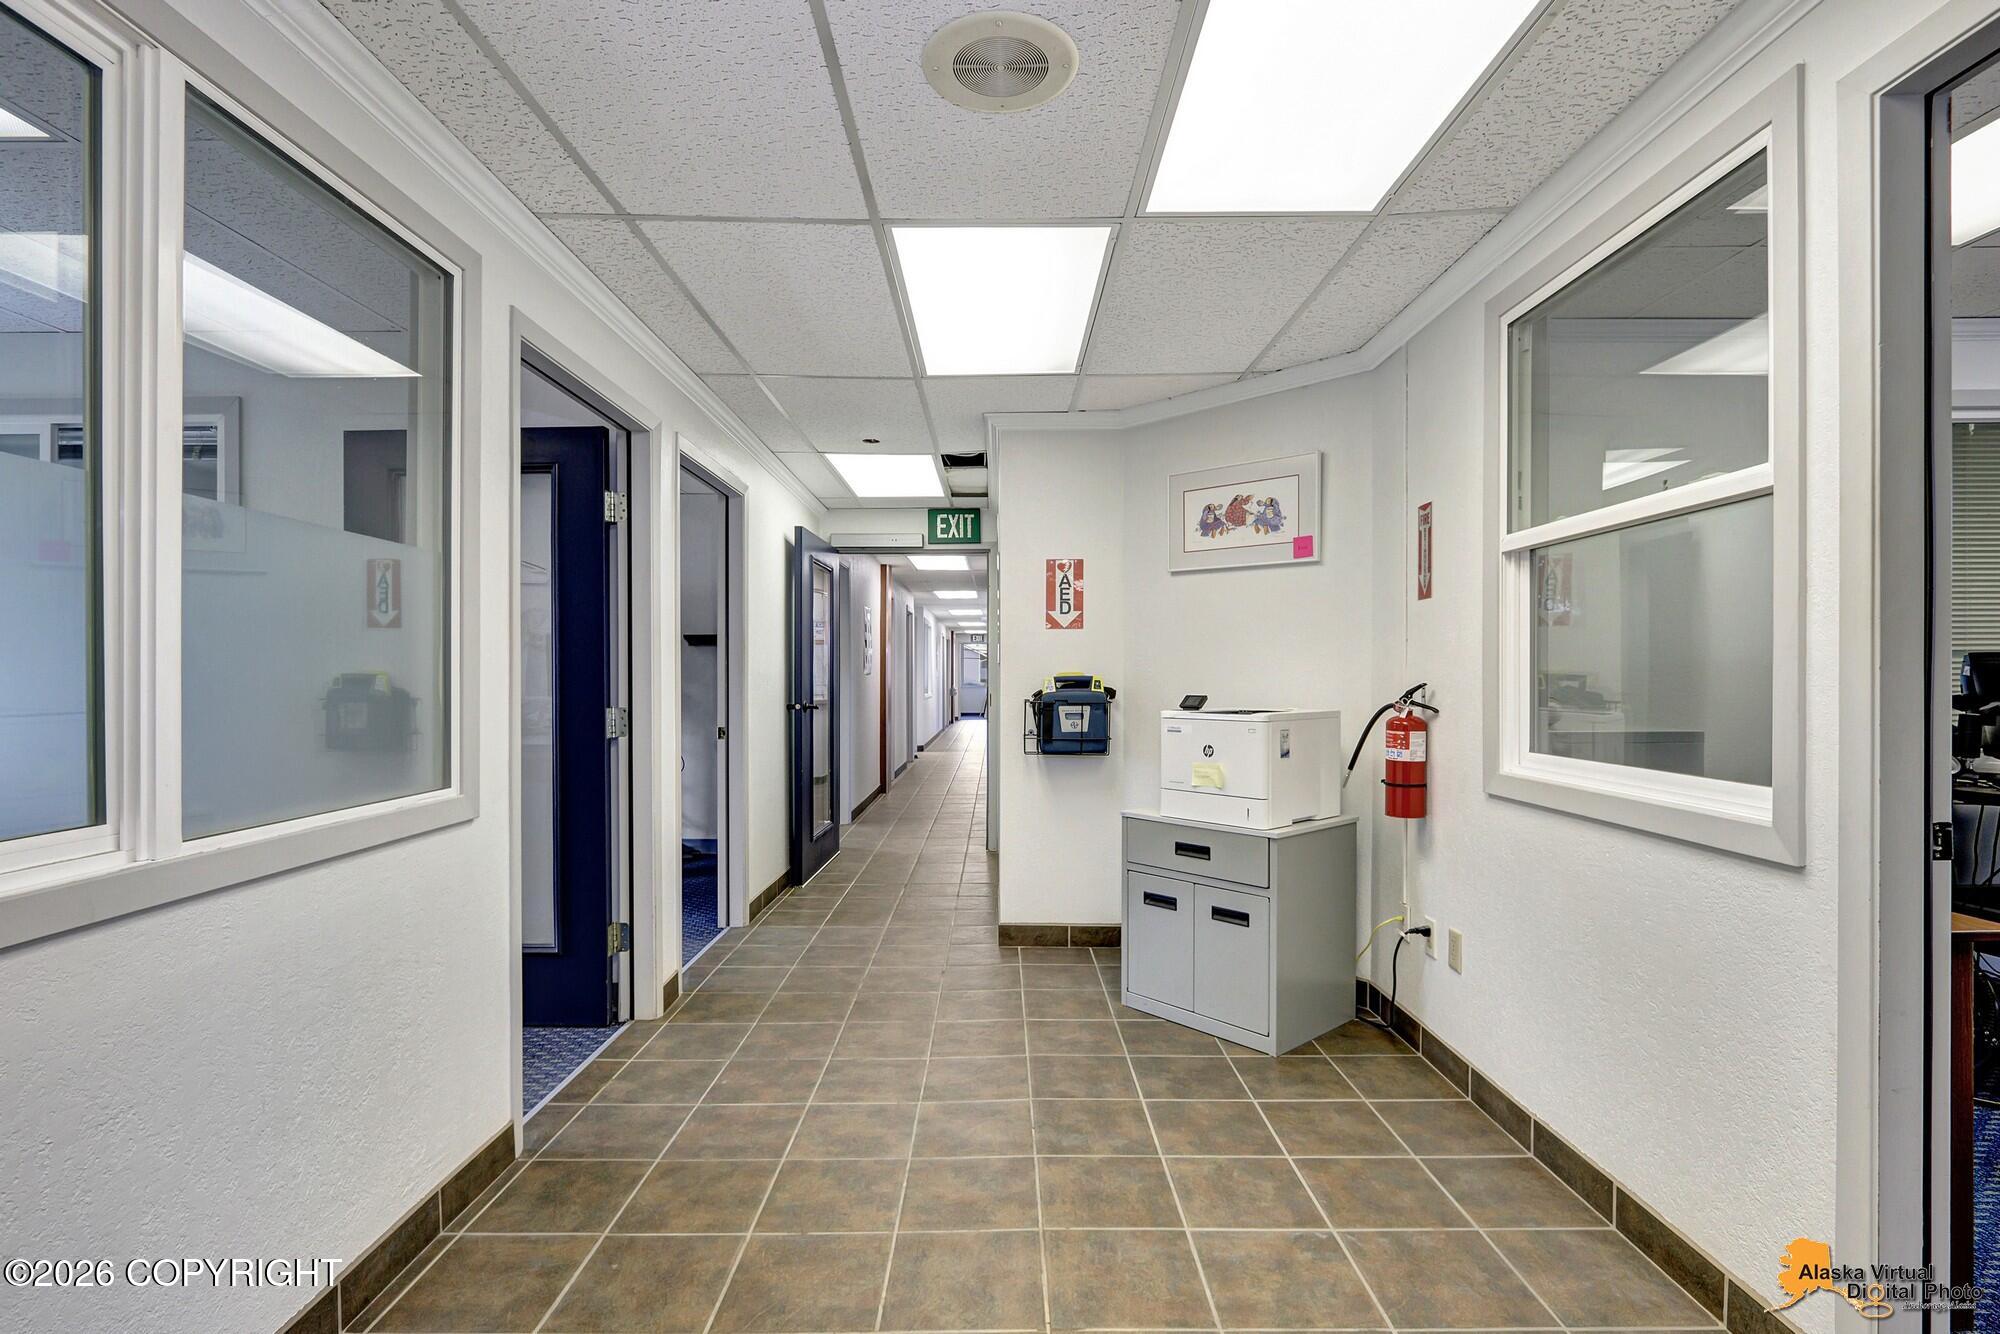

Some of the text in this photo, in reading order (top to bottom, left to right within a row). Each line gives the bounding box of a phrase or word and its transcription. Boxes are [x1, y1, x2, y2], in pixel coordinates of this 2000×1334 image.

[936, 514, 975, 538] EXIT
[1059, 573, 1072, 615] AED
[1203, 744, 1214, 758] hp
